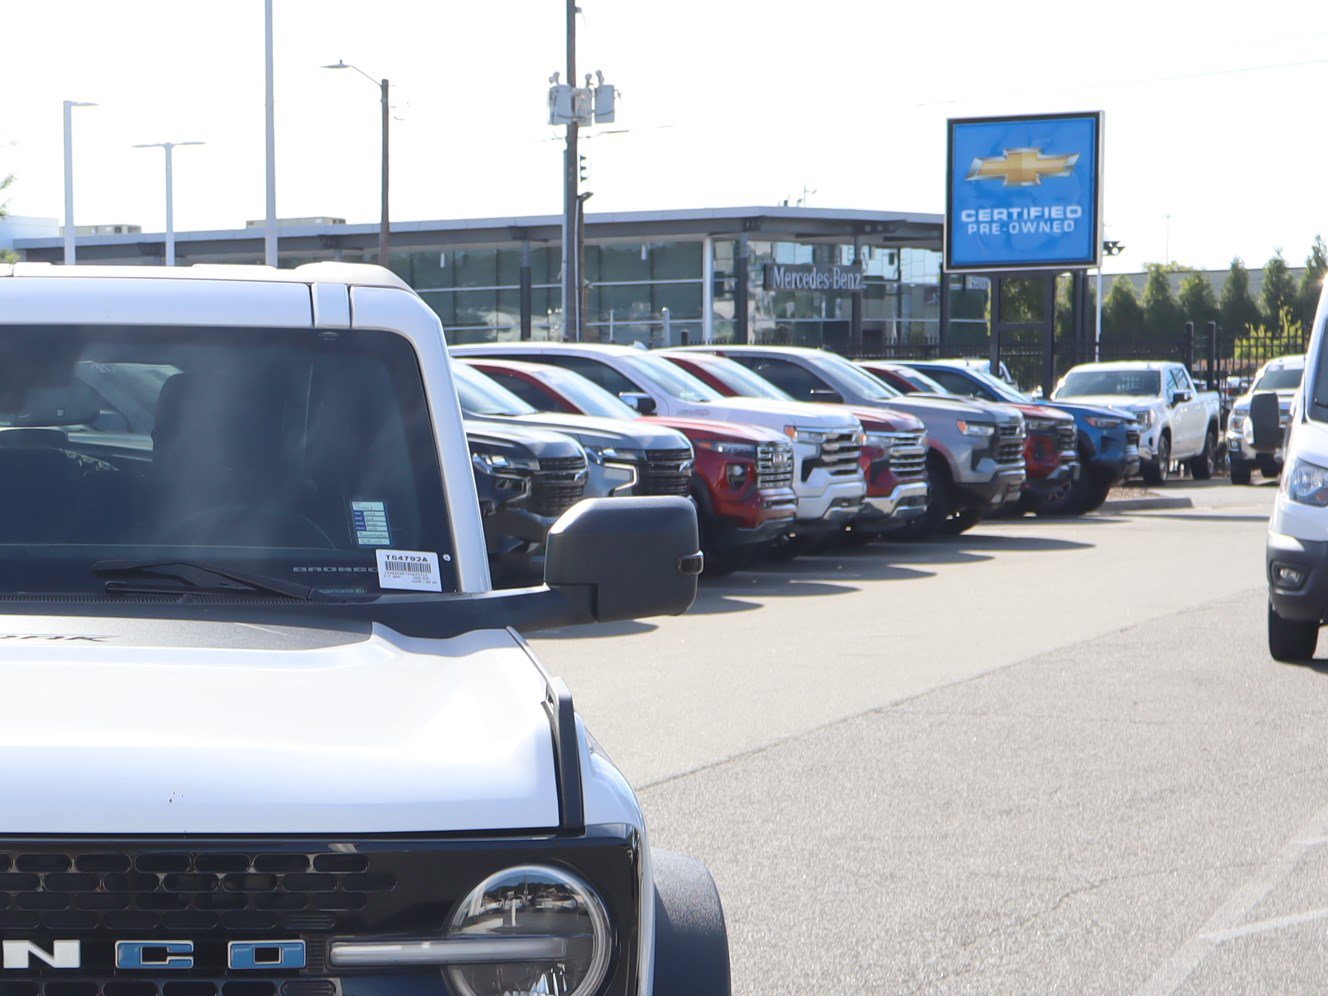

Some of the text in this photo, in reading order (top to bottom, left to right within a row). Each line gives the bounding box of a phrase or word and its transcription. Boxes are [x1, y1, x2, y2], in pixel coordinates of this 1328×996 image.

[960, 205, 1083, 223] CERTIFIED
[967, 219, 1076, 236] PRE-OWNED
[772, 266, 862, 290] Mercedes-Benz
